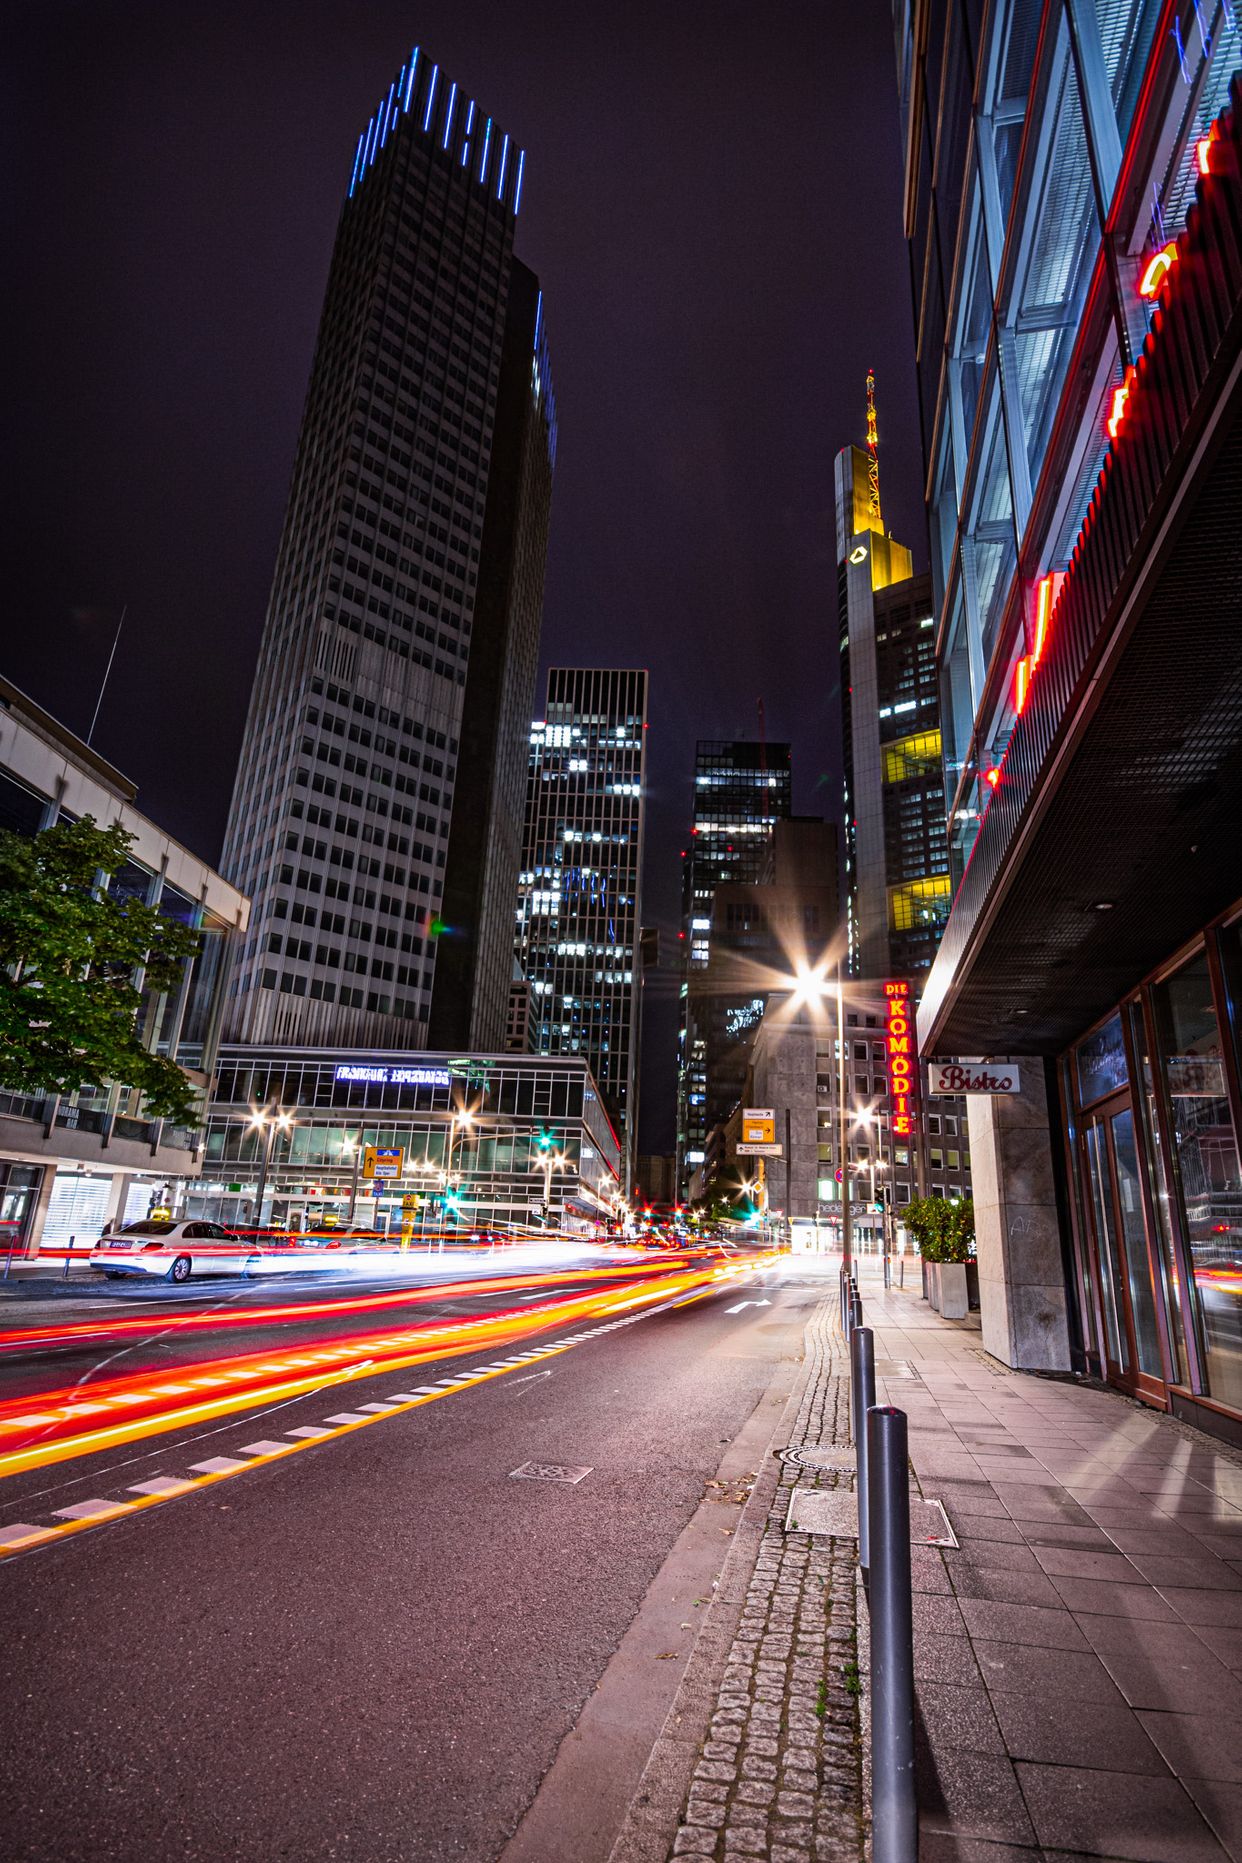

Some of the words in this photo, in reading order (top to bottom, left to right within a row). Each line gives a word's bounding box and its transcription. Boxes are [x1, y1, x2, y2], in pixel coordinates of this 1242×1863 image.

[886, 984, 907, 994] DIE
[889, 1000, 909, 1133] KOMÖDIE
[939, 1065, 1012, 1091] Bistro
